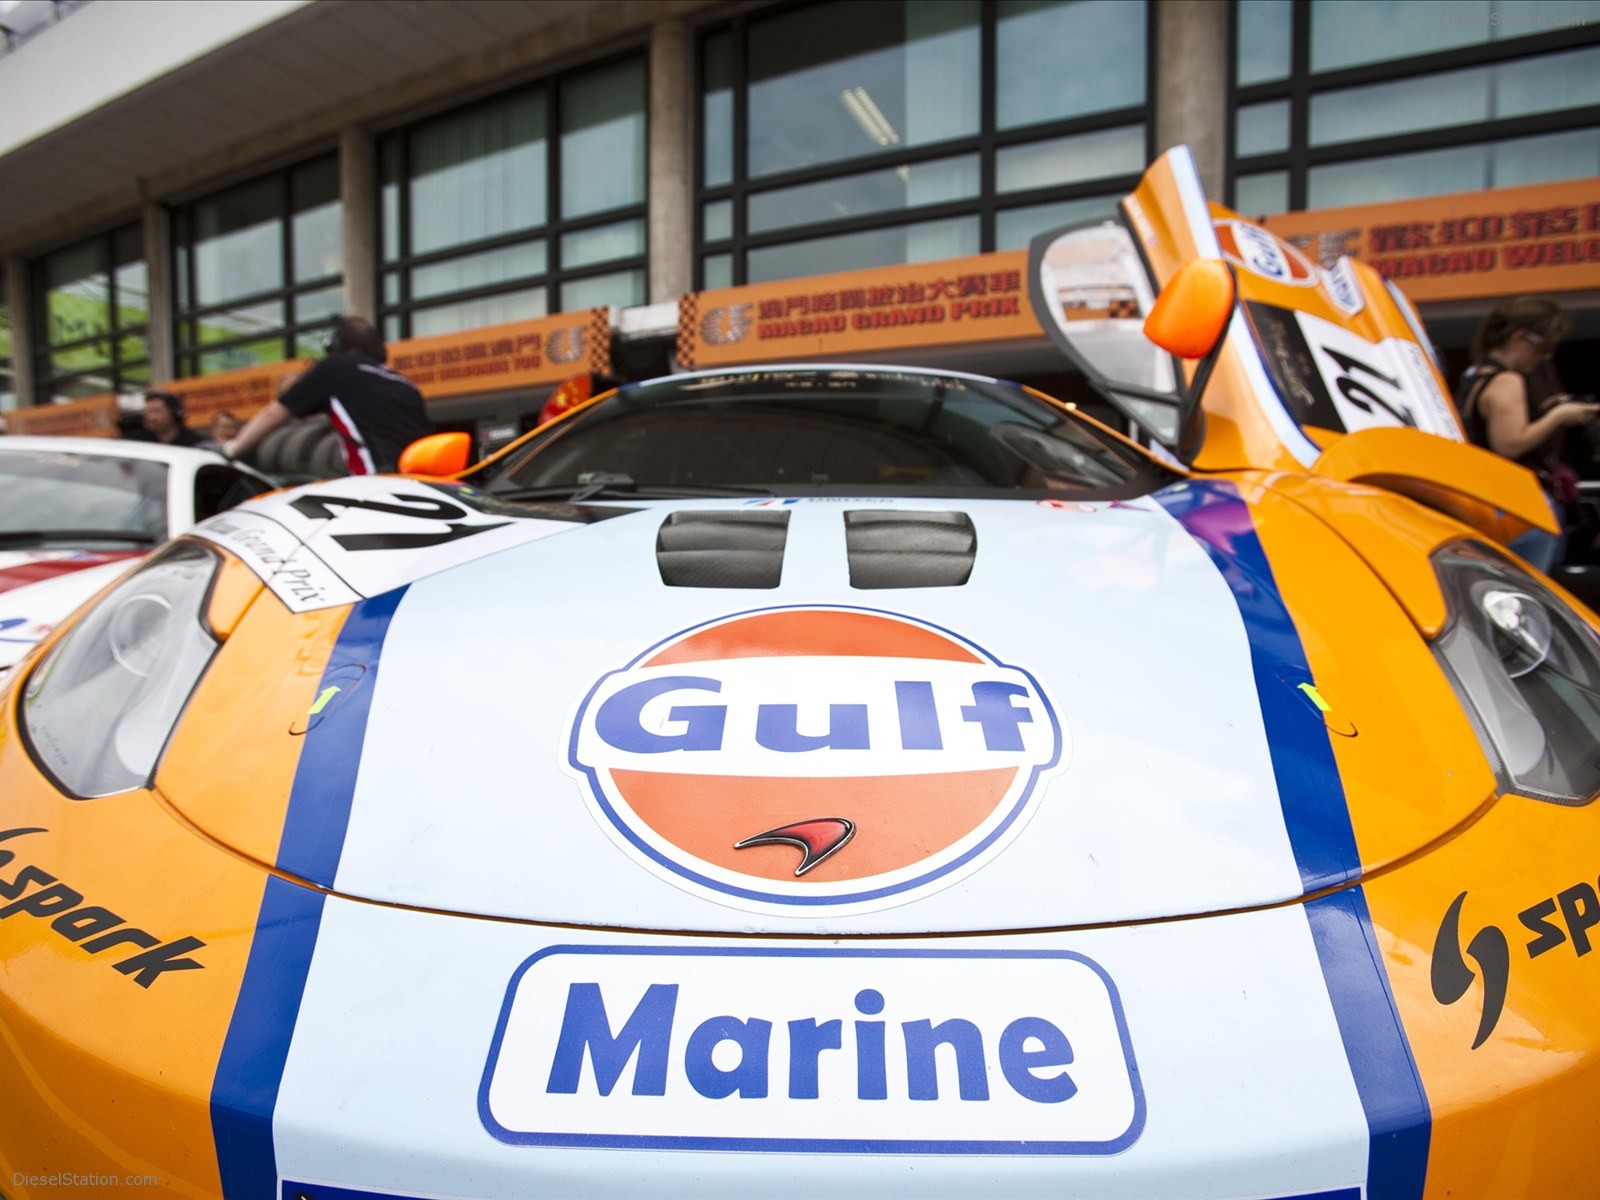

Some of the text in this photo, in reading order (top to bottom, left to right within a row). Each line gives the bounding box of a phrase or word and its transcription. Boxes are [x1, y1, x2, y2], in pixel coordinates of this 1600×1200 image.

[1370, 249, 1497, 278] MACAU
[757, 296, 1020, 341] MACAU GRAND PRIX
[1320, 344, 1419, 429] 21
[288, 494, 519, 552] 21
[276, 565, 326, 604] Prix
[594, 675, 1035, 754] Gulf
[0, 864, 208, 990] spark
[1517, 874, 1600, 960] sp
[545, 981, 1079, 1105] Marine
